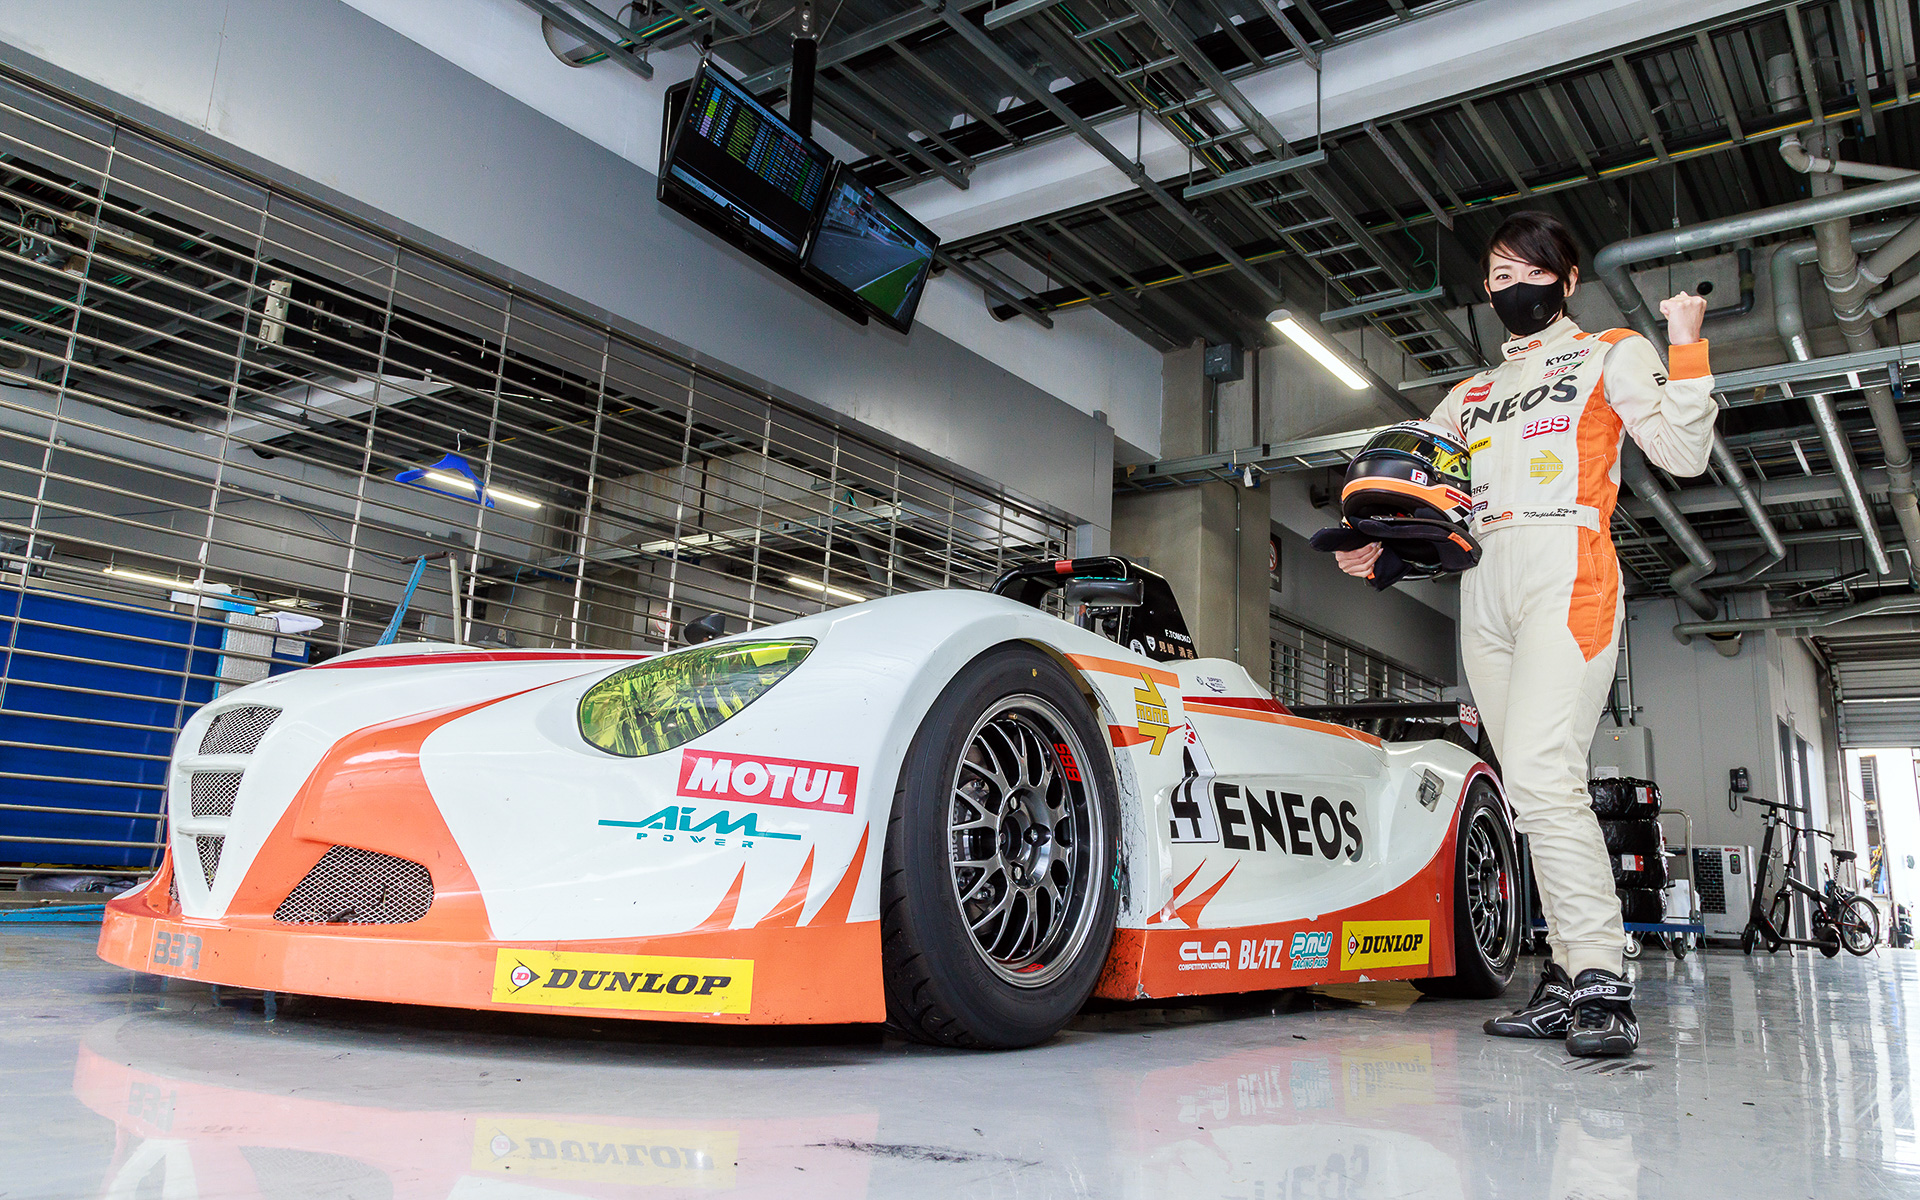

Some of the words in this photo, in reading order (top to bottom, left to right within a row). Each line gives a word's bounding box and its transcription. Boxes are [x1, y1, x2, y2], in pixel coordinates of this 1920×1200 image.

[1461, 375, 1578, 438] ENEOS
[1522, 414, 1571, 440] BBS
[1135, 703, 1170, 725] momo
[1460, 703, 1478, 728] BBS
[1053, 743, 1083, 782] BBS
[684, 757, 848, 806] MOTUL
[1213, 782, 1364, 863] ENEOS
[636, 833, 755, 849] POWER
[1179, 941, 1231, 961] CLA
[1238, 938, 1284, 970] BLITZ
[1360, 934, 1424, 954] DUNLOP
[542, 968, 732, 996] DUNLOP
